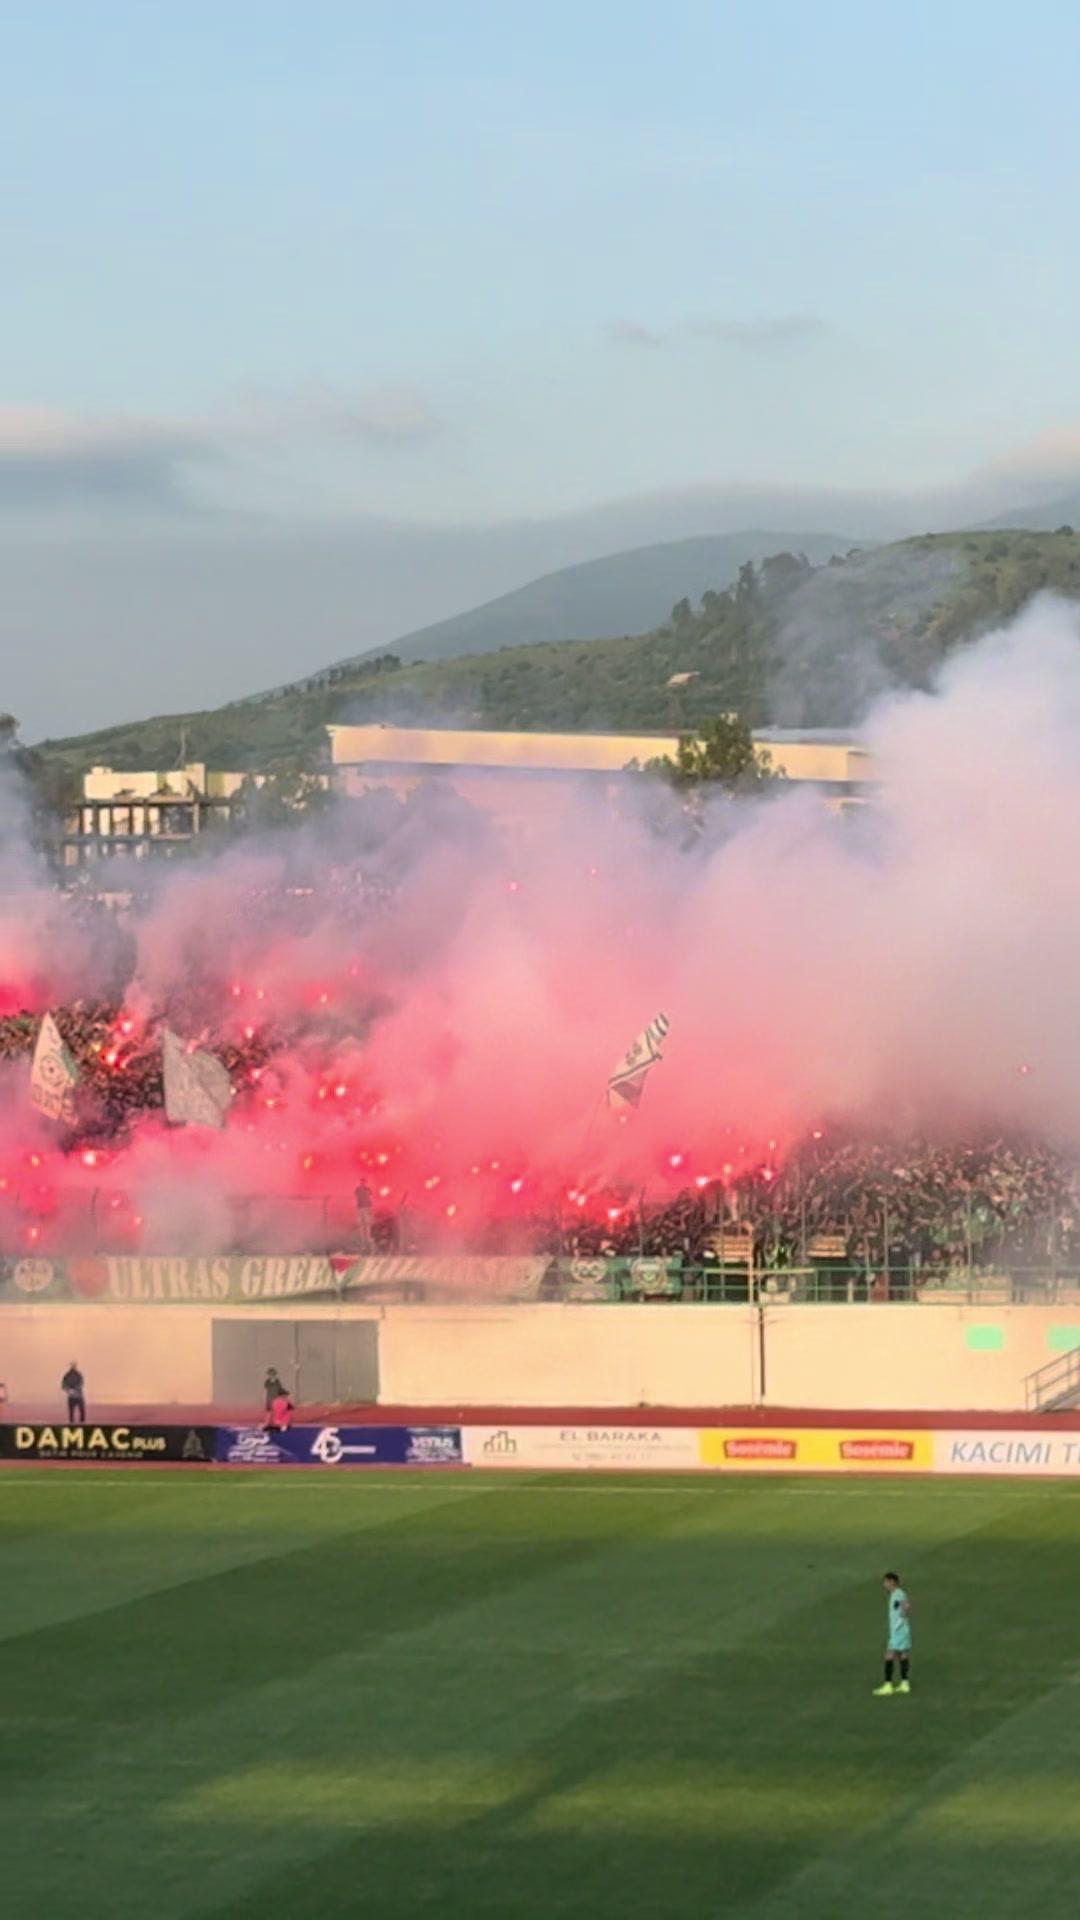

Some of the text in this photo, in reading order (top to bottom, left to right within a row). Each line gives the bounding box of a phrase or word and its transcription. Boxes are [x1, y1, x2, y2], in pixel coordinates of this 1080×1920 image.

[107, 1256, 231, 1298] ULTRAS
[16, 1427, 166, 1450] DAMAC PLUS
[560, 1431, 662, 1442] EL BARAKA
[950, 1441, 1080, 1464] KACIMI T
